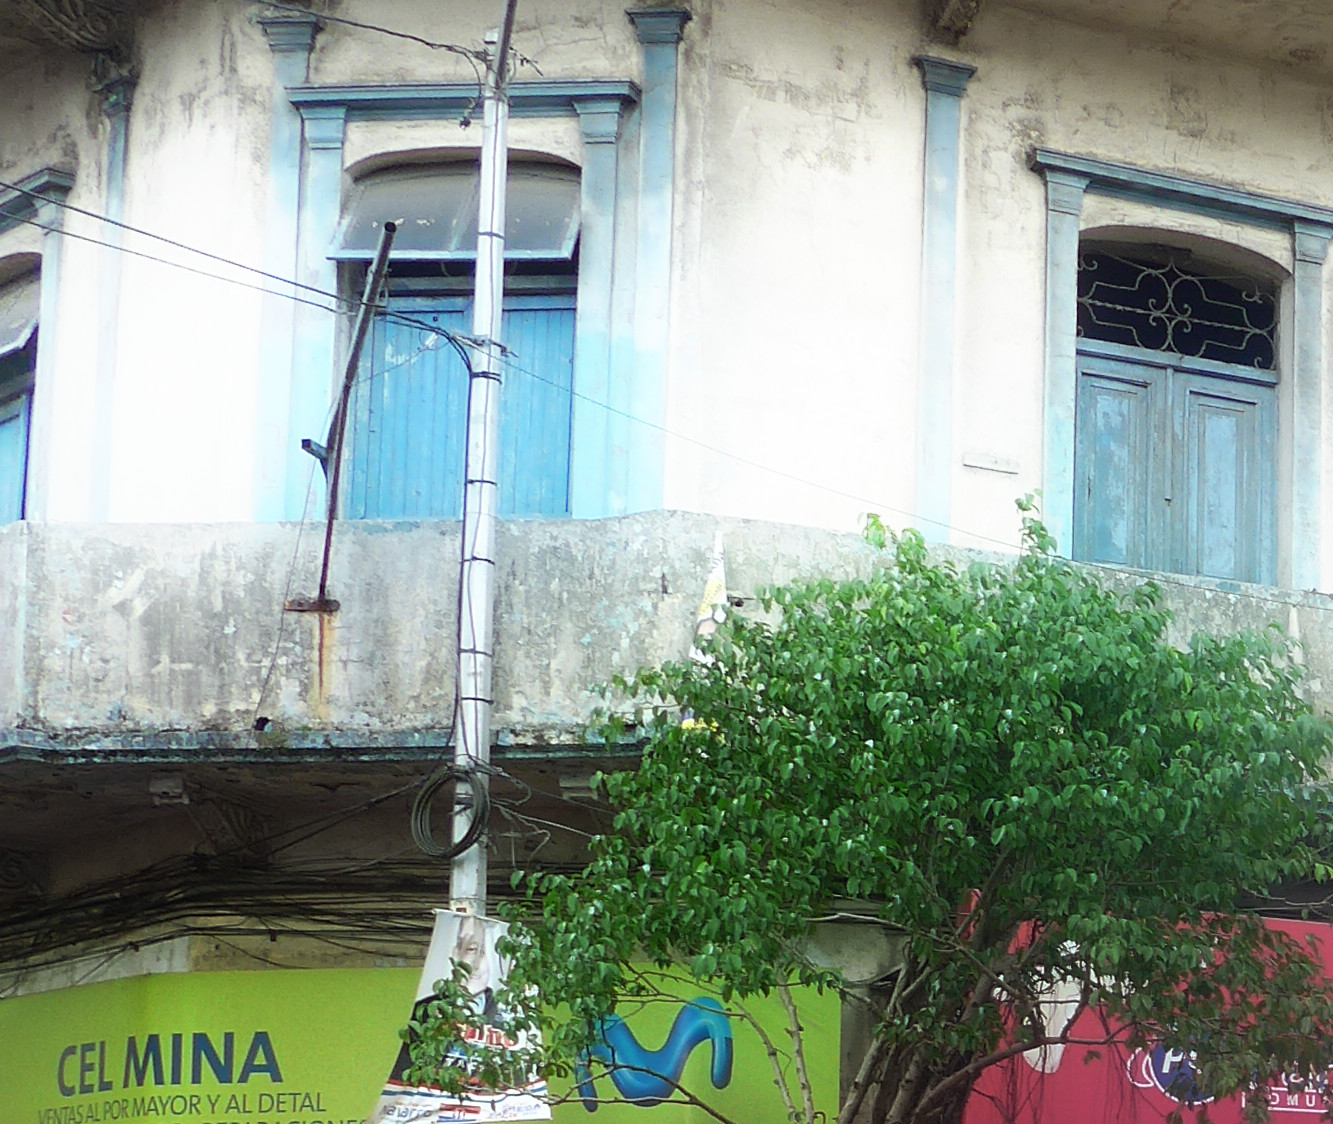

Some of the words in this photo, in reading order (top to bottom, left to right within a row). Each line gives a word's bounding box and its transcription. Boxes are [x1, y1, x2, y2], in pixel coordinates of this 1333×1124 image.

[57, 1041, 113, 1097] CEL
[123, 1031, 283, 1088] MINA
[84, 1104, 101, 1122] AL
[103, 1099, 129, 1121] POR
[131, 1095, 201, 1118] MAYOR
[207, 1094, 220, 1114] Y
[225, 1093, 252, 1113] AL
[258, 1092, 326, 1113] DETAL
